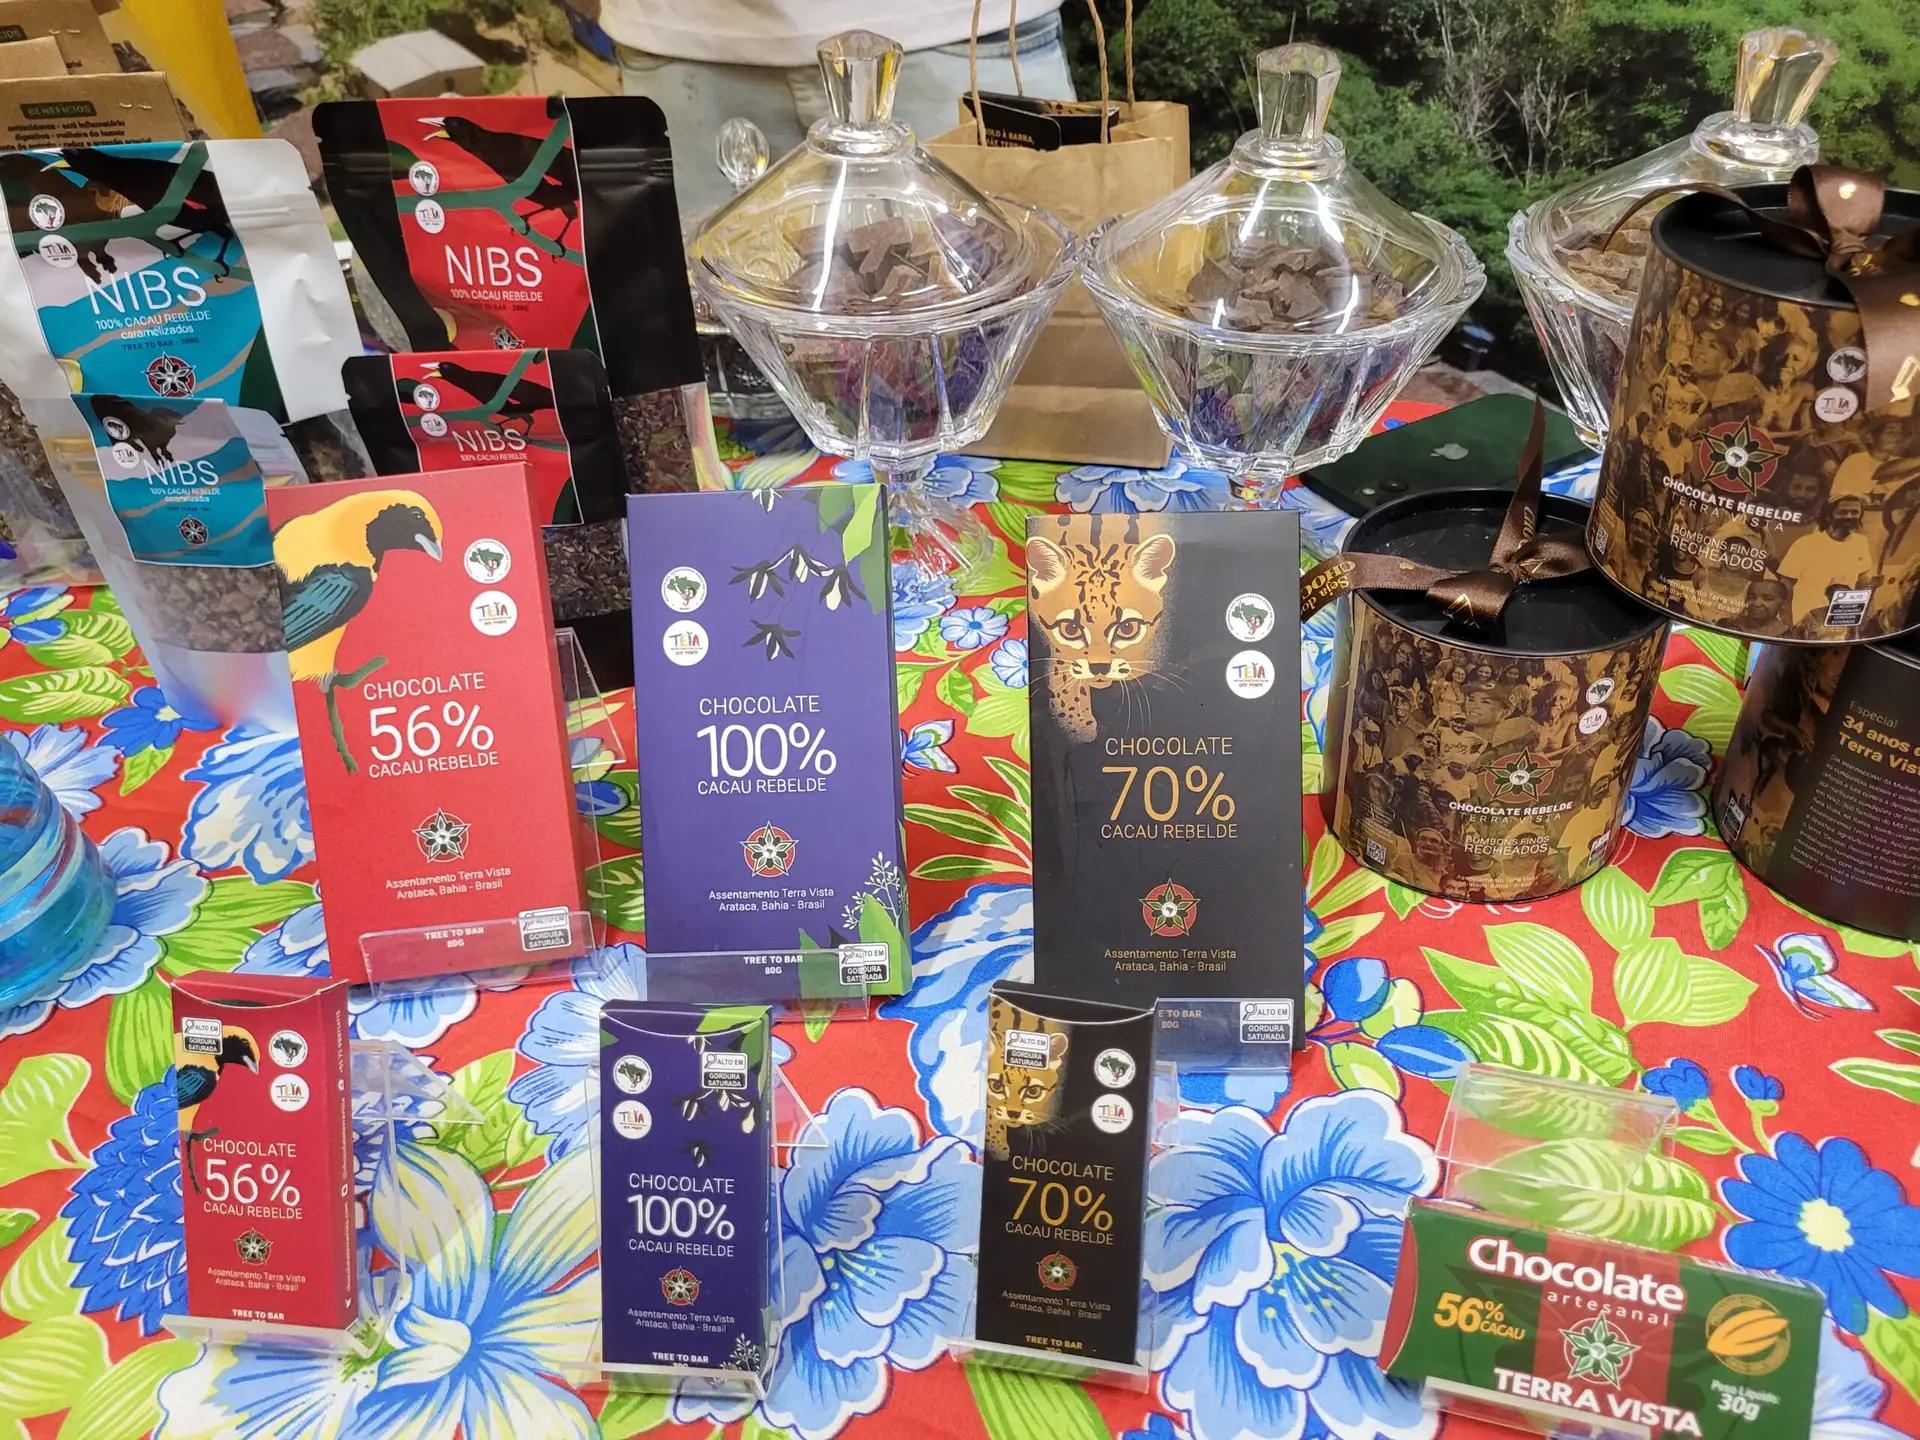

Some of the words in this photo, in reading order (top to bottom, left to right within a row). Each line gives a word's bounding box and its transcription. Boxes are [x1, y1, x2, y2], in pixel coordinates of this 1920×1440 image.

[444, 245, 543, 288] NIBS
[85, 266, 207, 315] NIBS
[450, 288, 471, 300] 100%
[471, 289, 501, 300] CACAU
[502, 290, 544, 302] REBELDE
[95, 318, 123, 331] 100%
[125, 315, 164, 328] CACAU
[165, 311, 212, 324] REBELDE
[121, 325, 194, 340] caramelizados
[452, 429, 527, 453] NIBS
[143, 460, 219, 486] NIBS
[1662, 476, 1735, 510] CHOCOLATE
[1736, 500, 1802, 523] REBELDE
[1671, 491, 1720, 519] TERRA
[1731, 512, 1785, 532] VISTA
[1672, 525, 1728, 551] BOMBONS
[1729, 542, 1768, 560] FINOS
[1670, 535, 1765, 572] RECHEADOS
[1318, 575, 1349, 597] Seja
[363, 672, 486, 701] CHOCOLATE
[699, 695, 820, 715] CHOCOLATE
[1850, 700, 1899, 729] Especial
[369, 701, 494, 761] 56%
[1842, 714, 1864, 734] 34
[1866, 727, 1910, 754] anos
[697, 722, 837, 778] 100%
[1105, 736, 1234, 756] CHOCOLATE
[1838, 731, 1883, 762] Terra
[369, 760, 424, 779] CACAU
[428, 751, 499, 771] REBELDE
[697, 780, 752, 795] CACAU
[756, 778, 827, 793] REBELDE
[1102, 765, 1236, 822] 70%
[1448, 801, 1522, 817] CHOCOLATE
[1523, 801, 1574, 817] REBELDE
[1459, 812, 1510, 825] TERRA
[1519, 811, 1562, 824] VISTA
[1101, 824, 1158, 839] CACAU
[1163, 823, 1238, 839] REBELDE
[1464, 843, 1548, 857] RECHEADOS
[1465, 835, 1518, 847] BOMBONS
[1520, 835, 1550, 846] FINOS
[386, 873, 457, 889] Assentamento
[458, 870, 484, 880] Terra
[485, 867, 511, 877] Vista
[397, 888, 438, 900] Arataca,
[439, 884, 467, 895] Bahia
[475, 879, 503, 891] Brasil
[709, 889, 780, 900] Assentamento
[781, 889, 807, 899] Terra
[809, 887, 834, 897] Vista
[719, 902, 759, 912] Arataca,
[761, 901, 789, 911] Bahia
[797, 900, 825, 910] Brasil
[425, 931, 449, 940] TREE
[450, 929, 463, 937] TO
[528, 931, 564, 941] GORDURA
[528, 938, 565, 948] SATURADA
[743, 956, 768, 965] TREE
[770, 955, 783, 964] TO
[784, 955, 803, 964] BAR
[855, 949, 873, 960] ALTO
[874, 949, 885, 957] EM
[1104, 949, 1179, 959] Assentamento
[1181, 949, 1208, 959] Terra
[1210, 949, 1237, 959] Vista
[764, 966, 783, 975] 80G
[1114, 961, 1157, 972] Arataca,
[1159, 961, 1188, 971] Bahia
[1197, 961, 1227, 971] Brasil
[846, 973, 883, 983] SATURADA
[1166, 1009, 1180, 1018] TO
[1182, 1009, 1202, 1018] BAR
[1257, 1008, 1275, 1016] ALTO
[1276, 1008, 1288, 1016] EM
[1161, 1020, 1180, 1029] 80G
[1248, 1024, 1285, 1033] GORDURA
[188, 1038, 217, 1046] GORDURA
[1019, 1037, 1036, 1045] ALTO
[1247, 1033, 1286, 1041] SATURADA
[1010, 1057, 1043, 1067] SATURADA
[1011, 1051, 1042, 1060] GORDURA
[708, 1079, 742, 1087] SATURADA
[203, 1138, 297, 1158] CHOCOLATE
[1012, 1155, 1114, 1181] CHOCOLATE
[206, 1158, 300, 1207] 56%
[629, 1172, 735, 1194] CHOCOLATE
[203, 1201, 244, 1217] CACAU
[247, 1205, 303, 1220] REBELDE
[1008, 1176, 1113, 1231] 70%
[627, 1194, 735, 1241] 100%
[1005, 1221, 1050, 1238] CACAU
[1054, 1227, 1114, 1245] REBELDE
[629, 1238, 673, 1254] CACAU
[676, 1242, 735, 1257] REBELDE
[1468, 1238, 1685, 1311] Chocolate
[232, 1309, 253, 1318] TREE
[255, 1310, 266, 1318] TO
[268, 1312, 285, 1320] BAR
[627, 1308, 688, 1321] Assentamento
[689, 1313, 711, 1323] Terra
[713, 1314, 735, 1324] Vista
[1433, 1292, 1504, 1333] 56%
[1546, 1289, 1670, 1327] artesanal
[1480, 1319, 1526, 1341] CACAU
[1026, 1335, 1048, 1345] TREE
[1050, 1338, 1062, 1347] TO
[1064, 1340, 1083, 1350] BAR
[652, 1352, 675, 1361] TREE
[677, 1354, 689, 1362] TO
[690, 1355, 709, 1363] BAR
[1494, 1367, 1600, 1412] TERRA
[1605, 1392, 1703, 1438] VISTA
[1717, 1394, 1760, 1421] 30g
